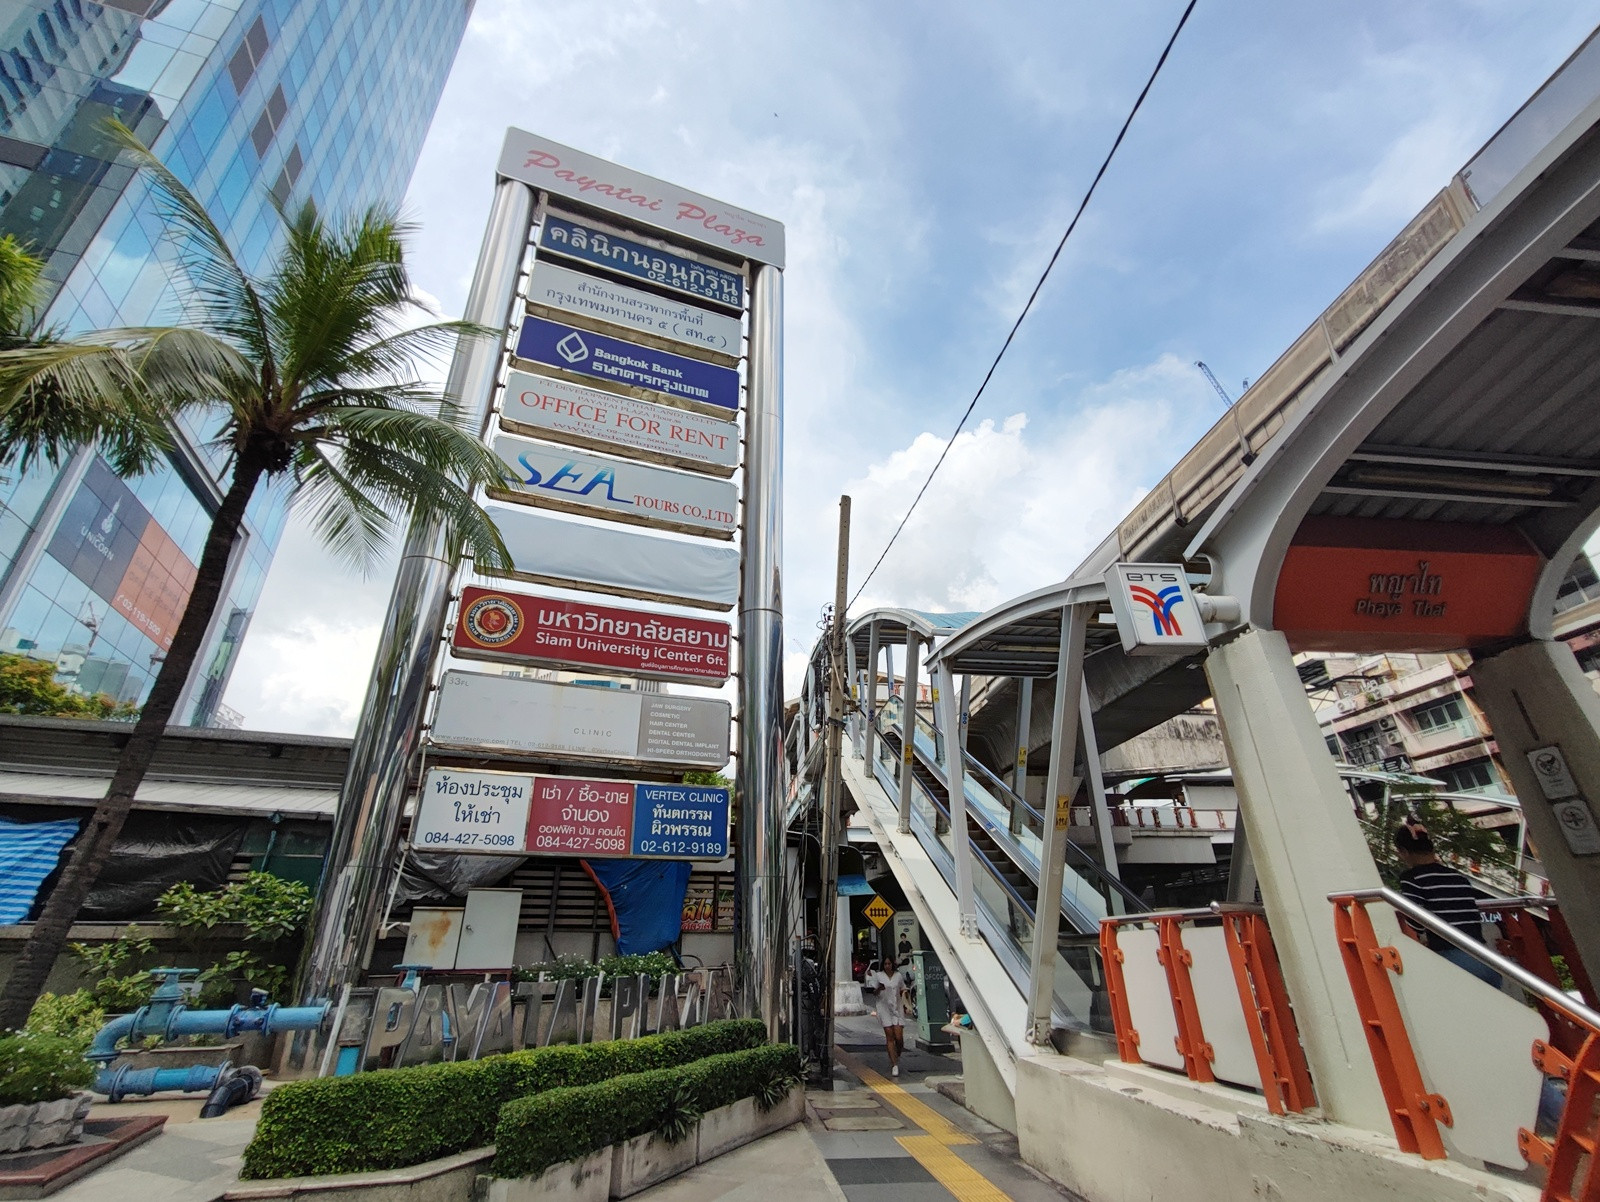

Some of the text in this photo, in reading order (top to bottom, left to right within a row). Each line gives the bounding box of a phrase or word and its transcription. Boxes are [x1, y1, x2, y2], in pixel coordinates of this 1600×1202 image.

[523, 150, 766, 247] Payatai Plaza
[550, 225, 738, 296] คลินิกนอนกรน
[647, 270, 738, 305] 02-612-9188
[546, 288, 653, 325] กรุงเทพมหานคร
[578, 281, 703, 326] สำนักงานสรรพากรพื้นที่
[594, 347, 683, 379] Bangkok Bank
[592, 361, 710, 399] ธนาคารกรุงเทพ
[520, 391, 729, 451] OFFICE FOR RENT
[504, 450, 634, 504] SEA
[634, 494, 734, 524] TOURS CO.,LTD
[81, 525, 114, 561] UNICORN
[1125, 572, 1178, 582] BTS
[1369, 560, 1442, 600] พญาไท
[1355, 599, 1447, 618] Phaya Thai
[538, 608, 728, 648] มหาวิทยาลัยสยาม
[535, 631, 572, 648] Siam
[576, 636, 650, 660] University
[653, 647, 703, 666] iCenter
[573, 727, 612, 738] CLINIC
[648, 729, 696, 739] DENTAL CENTER
[664, 721, 688, 729] CENTER
[648, 738, 720, 750] DIGITAL DENTAL IMPLANT
[675, 749, 720, 758] ORTHODONTICS
[435, 774, 523, 805] ห้องประชุม
[541, 784, 561, 800] เช่า
[578, 783, 629, 804] ซื้อ-ขาย
[645, 789, 724, 804] VERTEX CLINIC
[453, 800, 501, 824] ให้เช่า
[561, 803, 610, 823] จำนอง
[652, 803, 713, 821] ทันตกรรม
[424, 831, 515, 846] 084-427-5098
[578, 825, 595, 836] บ้าน
[597, 825, 626, 837] คอนโด
[651, 819, 712, 837] ผิวพรรณ
[536, 835, 626, 851] 084-427-5098
[640, 839, 722, 855] 02-612-9189
